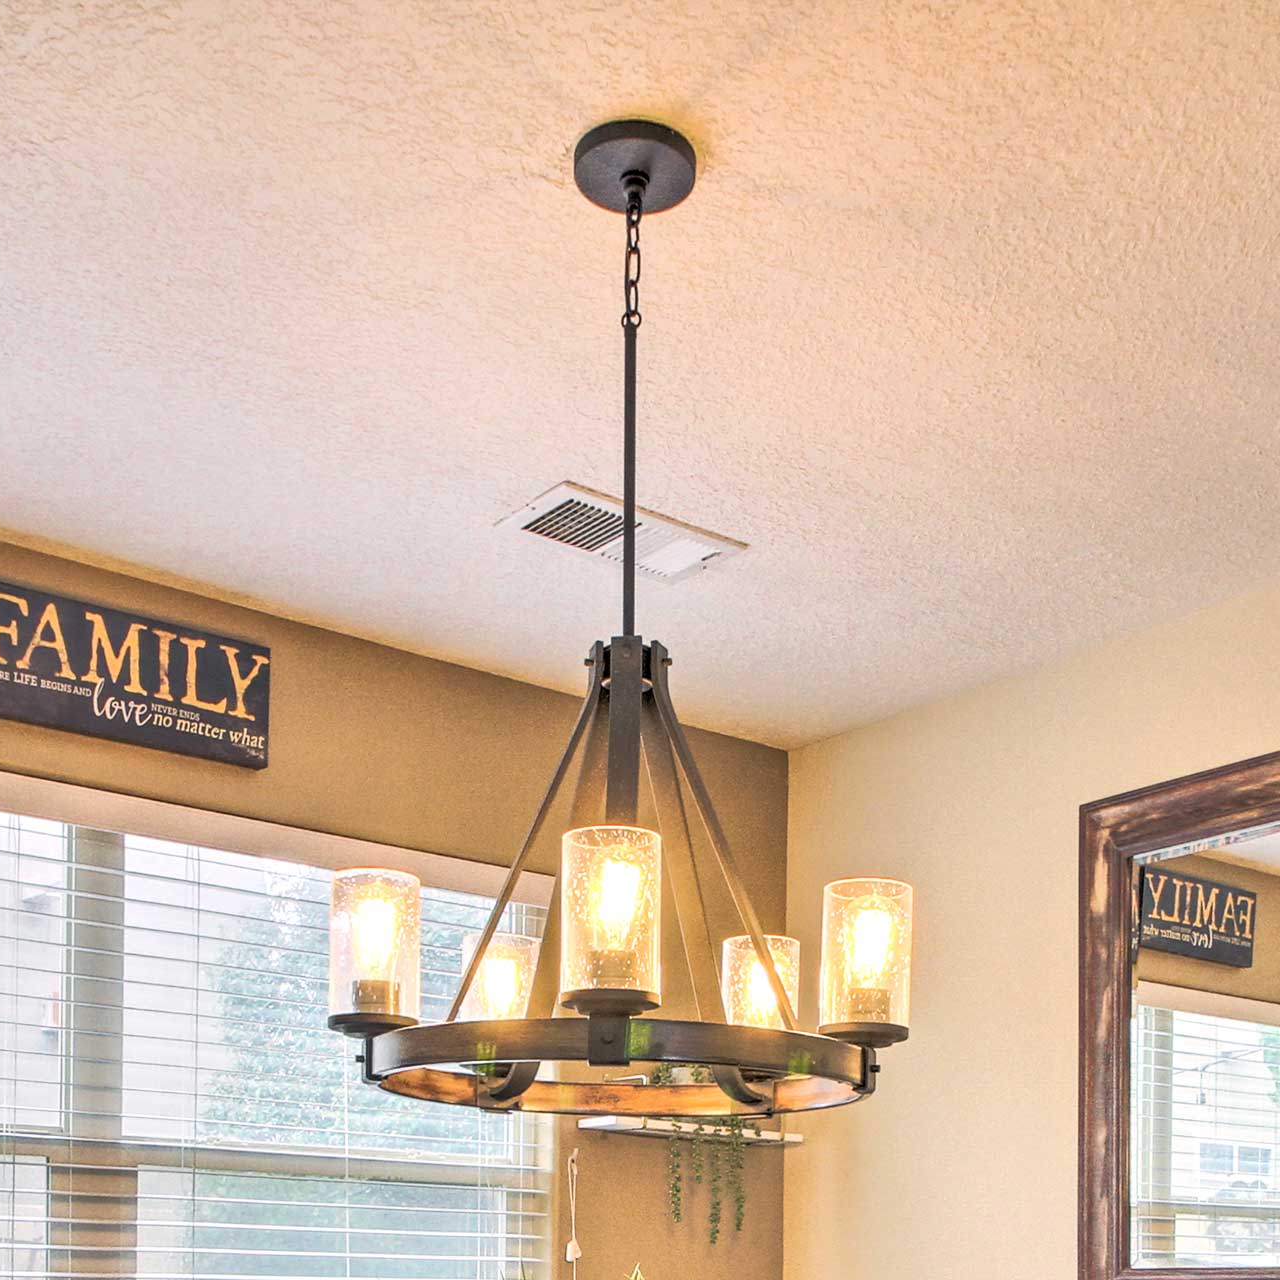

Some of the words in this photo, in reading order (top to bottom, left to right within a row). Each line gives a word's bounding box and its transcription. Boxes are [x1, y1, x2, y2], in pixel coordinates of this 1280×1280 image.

[13, 672, 38, 687] LIFE
[40, 679, 72, 693] BEGINS
[72, 686, 92, 697] AND
[93, 677, 152, 726] love
[151, 703, 178, 716] NEVER
[179, 710, 200, 721] ENDS
[152, 714, 173, 728] no
[175, 719, 226, 740] matter
[229, 728, 265, 749] what
